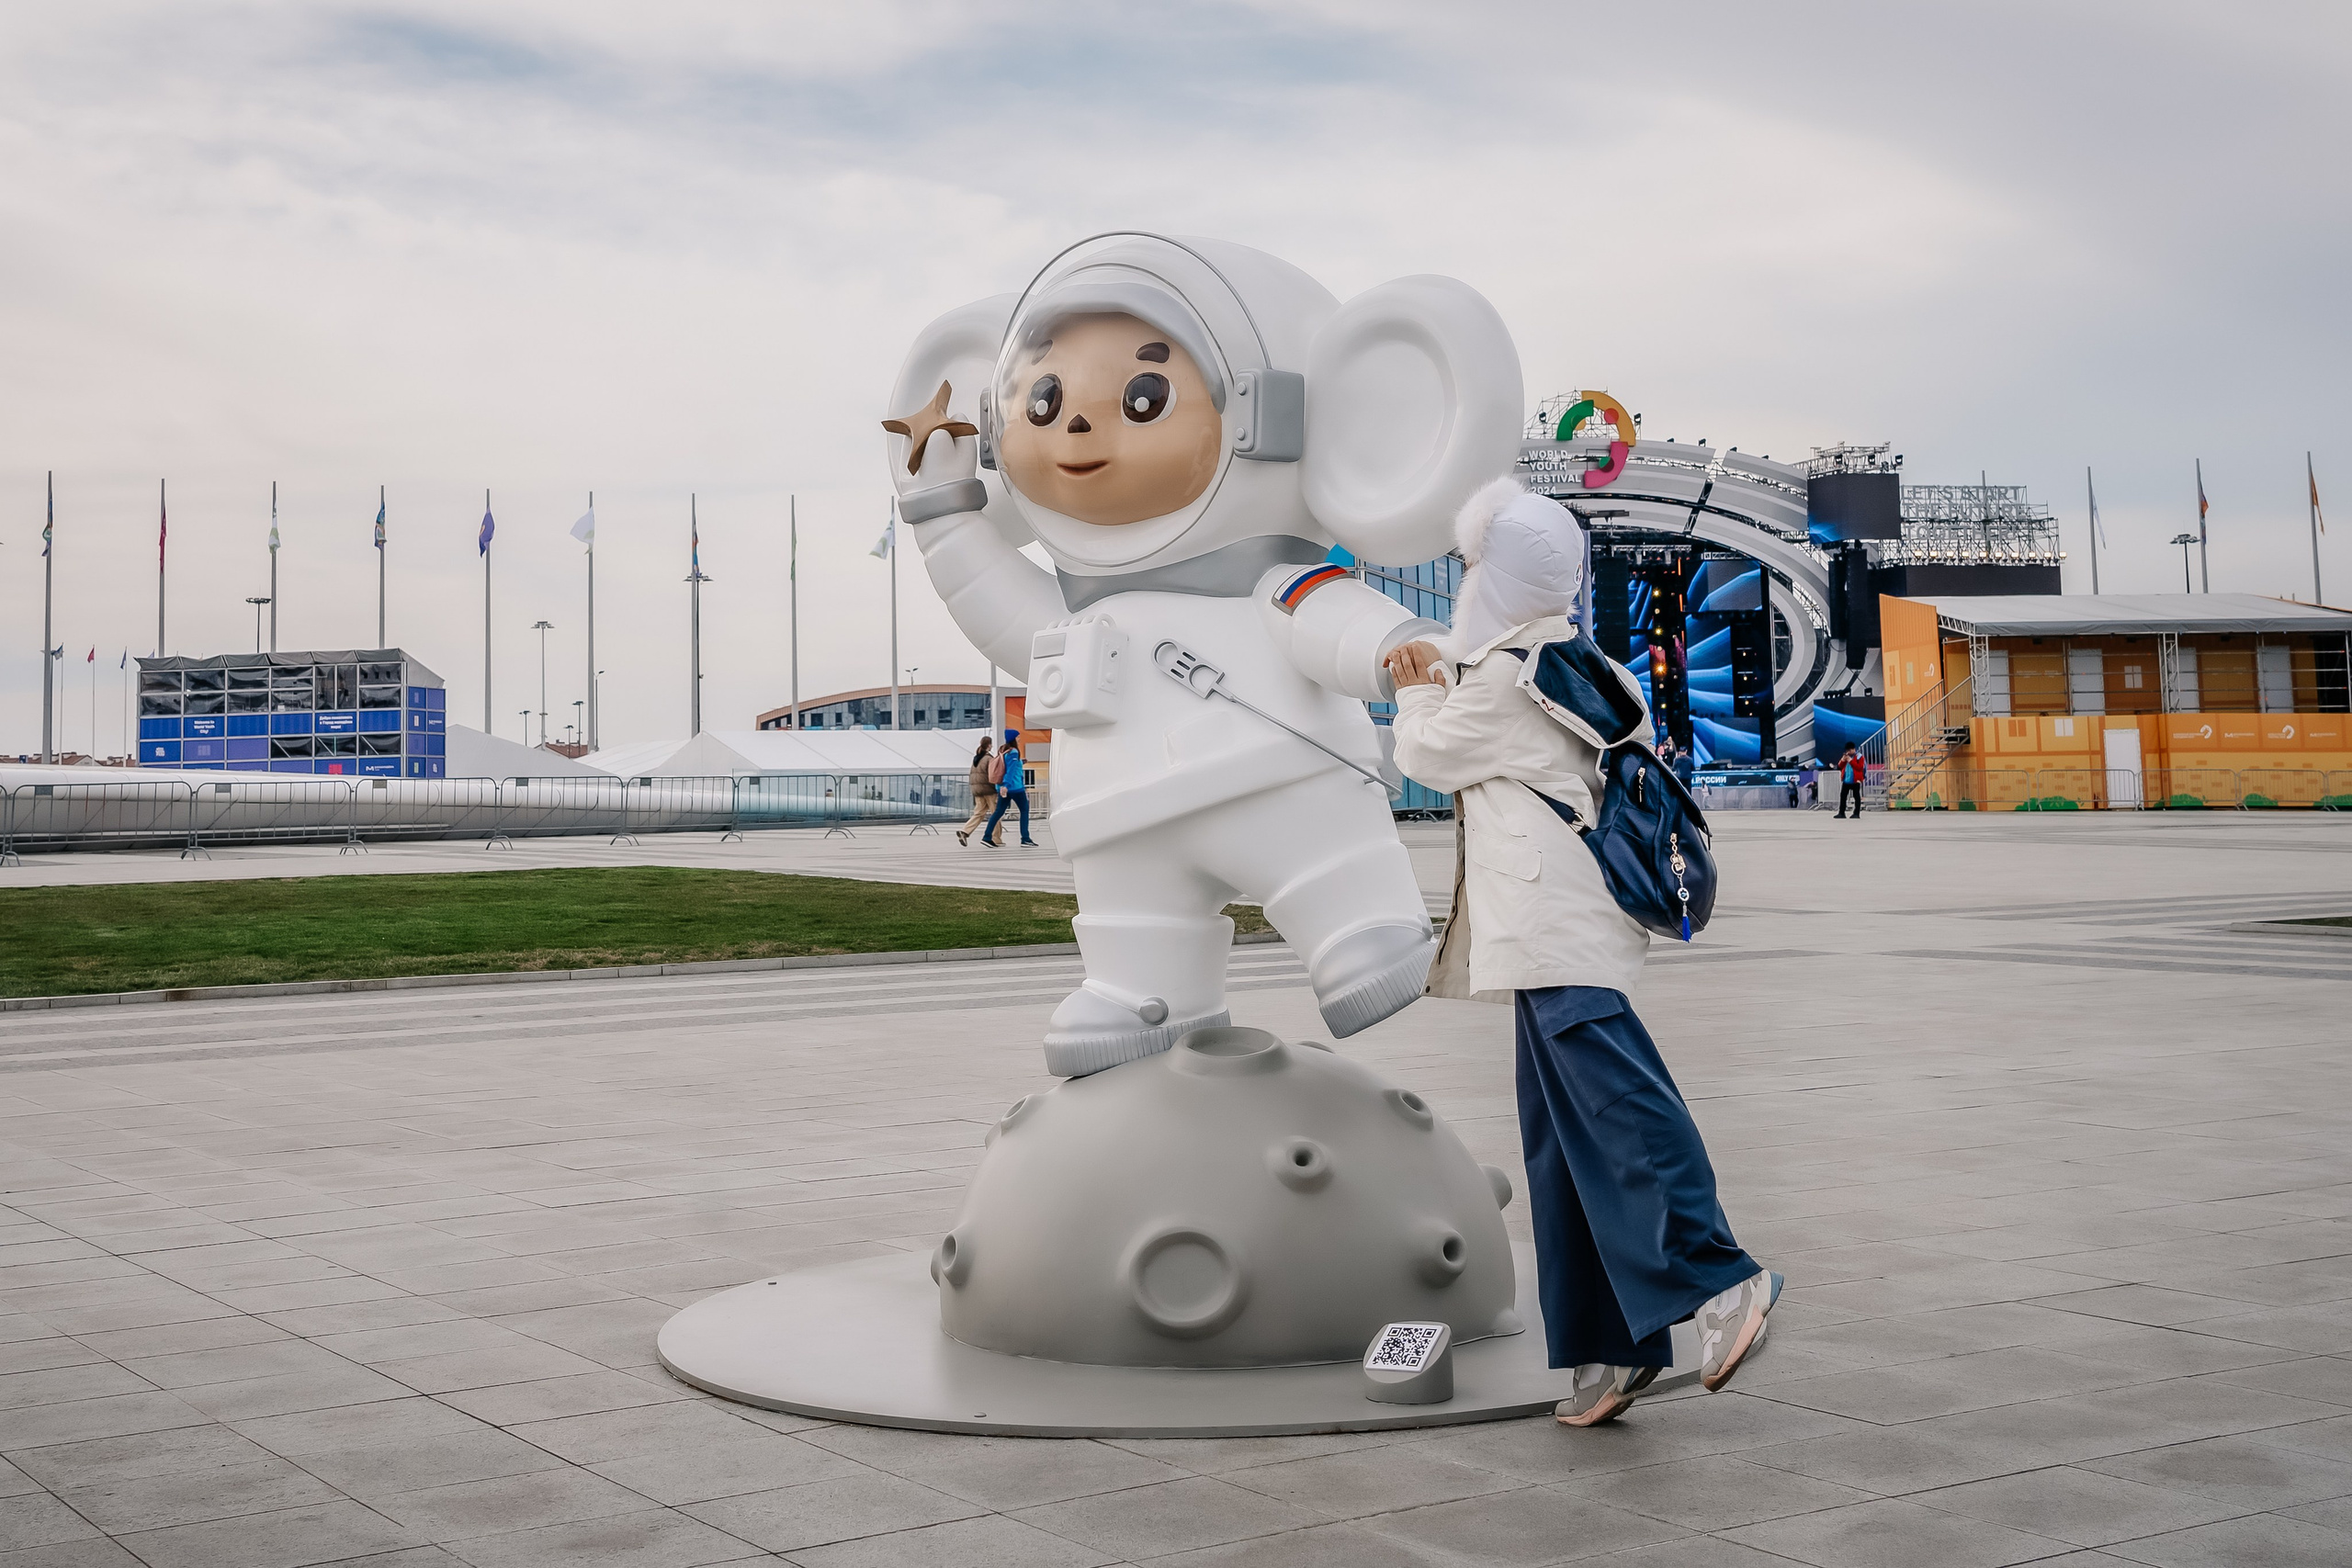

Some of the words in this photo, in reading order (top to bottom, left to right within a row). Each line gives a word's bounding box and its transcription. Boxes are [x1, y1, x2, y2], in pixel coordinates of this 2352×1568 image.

[1528, 449, 1567, 460] WORLD
[1530, 461, 1567, 471] YOUTH
[1531, 474, 1581, 483] FESTIVAL
[1531, 486, 1556, 495] 2024
[1901, 485, 1953, 501] LET'S
[1960, 485, 2021, 501] START
[1902, 503, 1940, 520] THE
[1947, 503, 2027, 520] FUTURE
